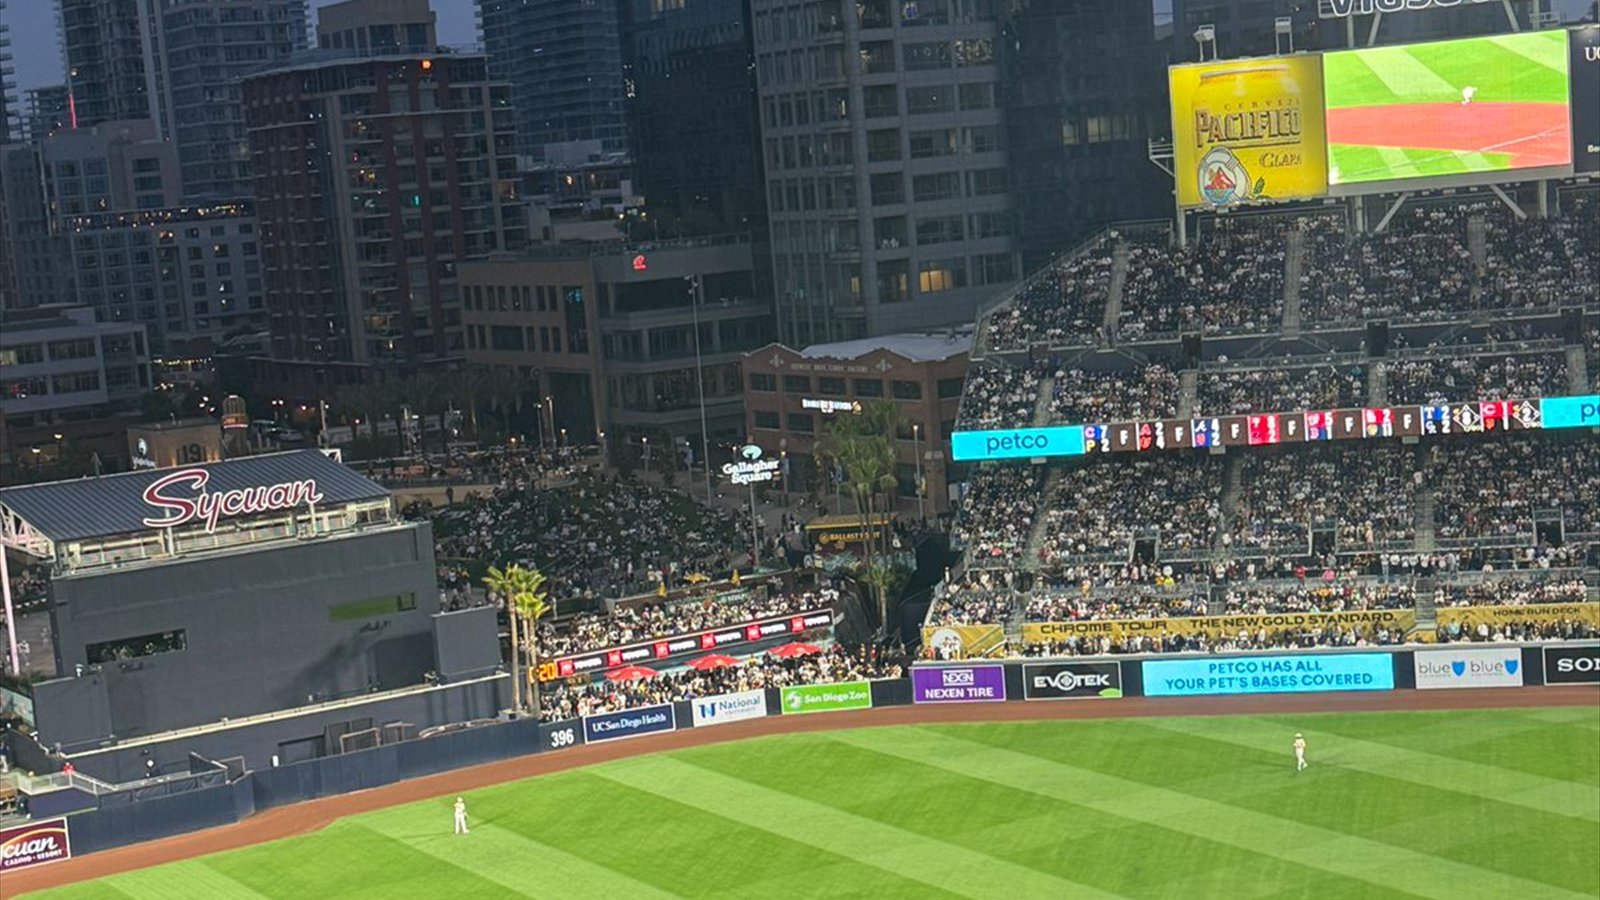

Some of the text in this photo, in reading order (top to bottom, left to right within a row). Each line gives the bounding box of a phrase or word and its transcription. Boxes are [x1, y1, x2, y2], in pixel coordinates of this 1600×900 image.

[1195, 108, 1301, 148] PACIFICO
[1441, 405, 1450, 419] 2
[1522, 407, 1532, 421] 2
[1288, 420, 1296, 436] F
[1345, 416, 1354, 432] F
[1403, 413, 1412, 429] F
[1442, 419, 1451, 434] 2
[1120, 430, 1128, 445] F
[1155, 422, 1164, 436] 2
[1175, 426, 1184, 442] F
[1212, 432, 1220, 446] 2
[1231, 423, 1240, 439] F
[1268, 429, 1277, 443] 2
[986, 431, 1048, 454] petco
[1101, 439, 1110, 452] 2
[722, 459, 779, 476] Gallagher
[731, 471, 772, 485] Square
[143, 469, 323, 534] Sycuan
[1040, 622, 1113, 635] CHROME
[1117, 620, 1168, 633] TOUR
[1189, 617, 1223, 628] THE
[1224, 616, 1259, 628] NEW
[1262, 615, 1305, 627] GOLD
[1209, 660, 1323, 674] PETCO HAS ALL
[1419, 661, 1451, 674] blue
[1470, 660, 1504, 673] blue
[1033, 671, 1110, 691] EVOTEK
[1166, 672, 1373, 690] YOUR PET'S BASES COVERED
[804, 694, 823, 704] San
[823, 692, 849, 703] Diego
[925, 687, 994, 699] NEXEN TIRE
[719, 696, 761, 709] National
[592, 712, 666, 733] UC San Diego Health
[551, 728, 574, 747] 396
[1, 836, 58, 858] cuan
